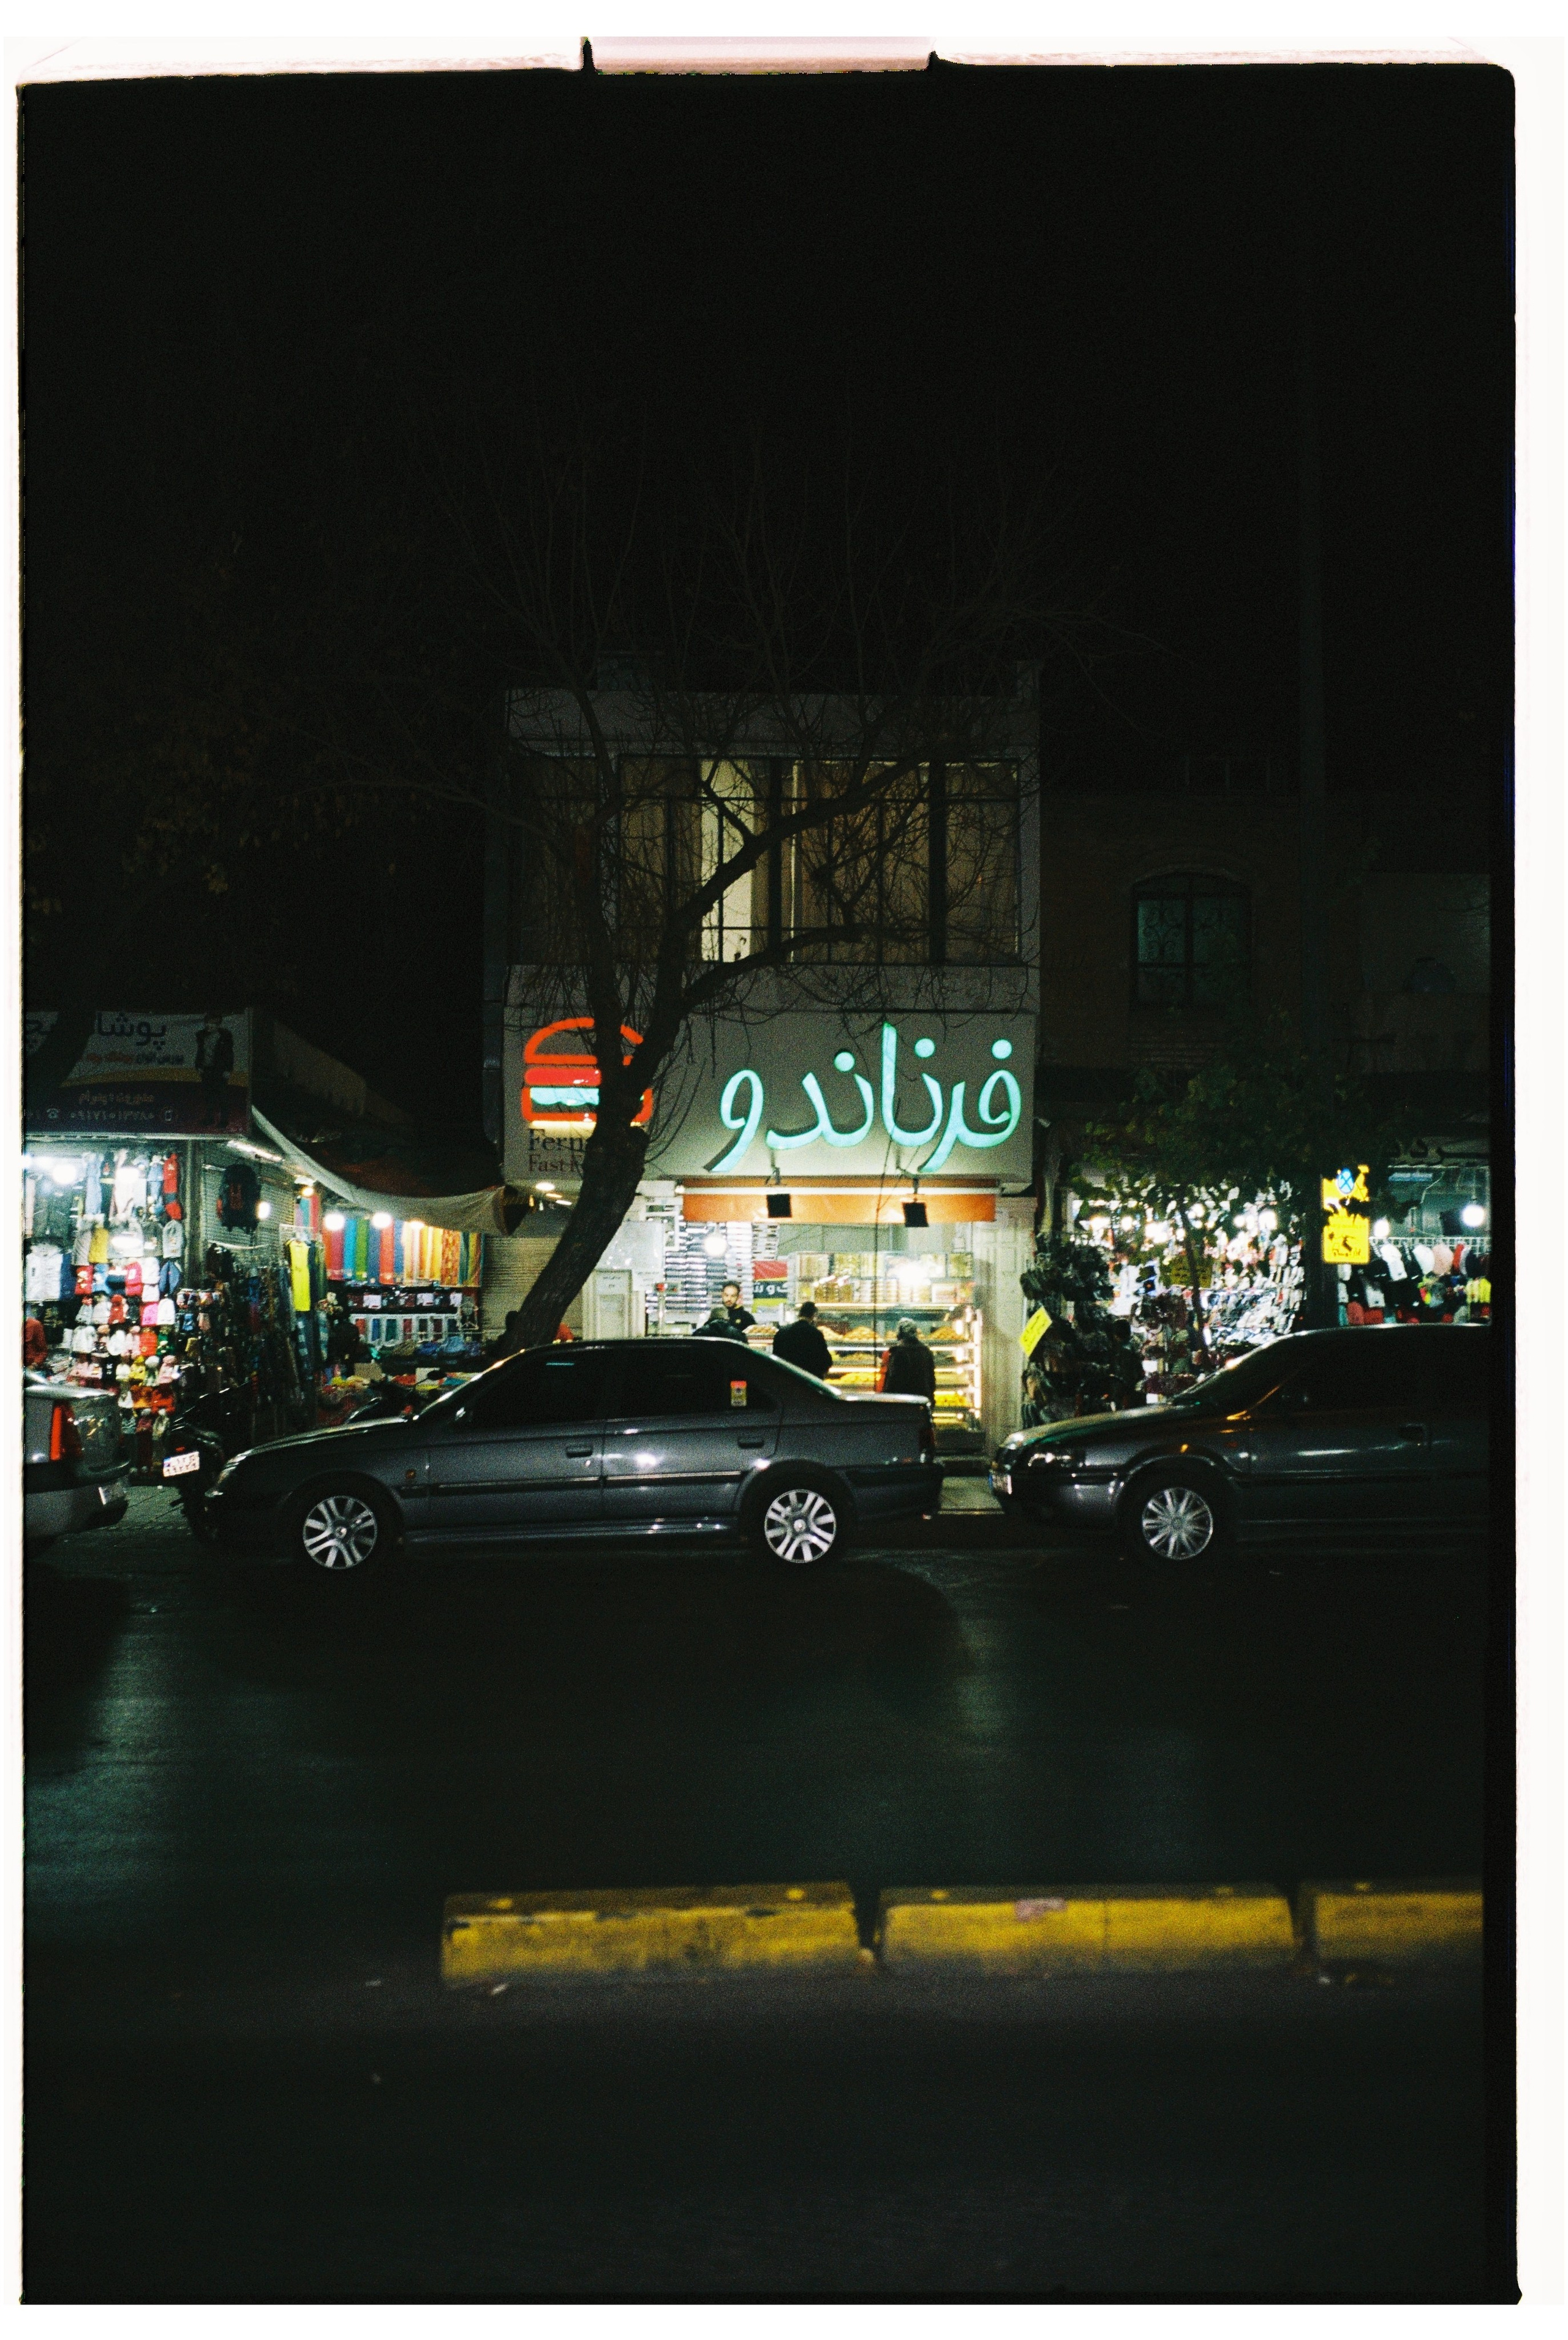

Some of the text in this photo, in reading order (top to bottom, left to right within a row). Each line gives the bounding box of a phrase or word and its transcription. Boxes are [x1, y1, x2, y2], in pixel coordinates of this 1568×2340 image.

[96, 1012, 167, 1051] پوشا
[708, 1022, 1022, 1172] فرناندو
[527, 1128, 585, 1151] Fern
[529, 1153, 584, 1172] Fast F
